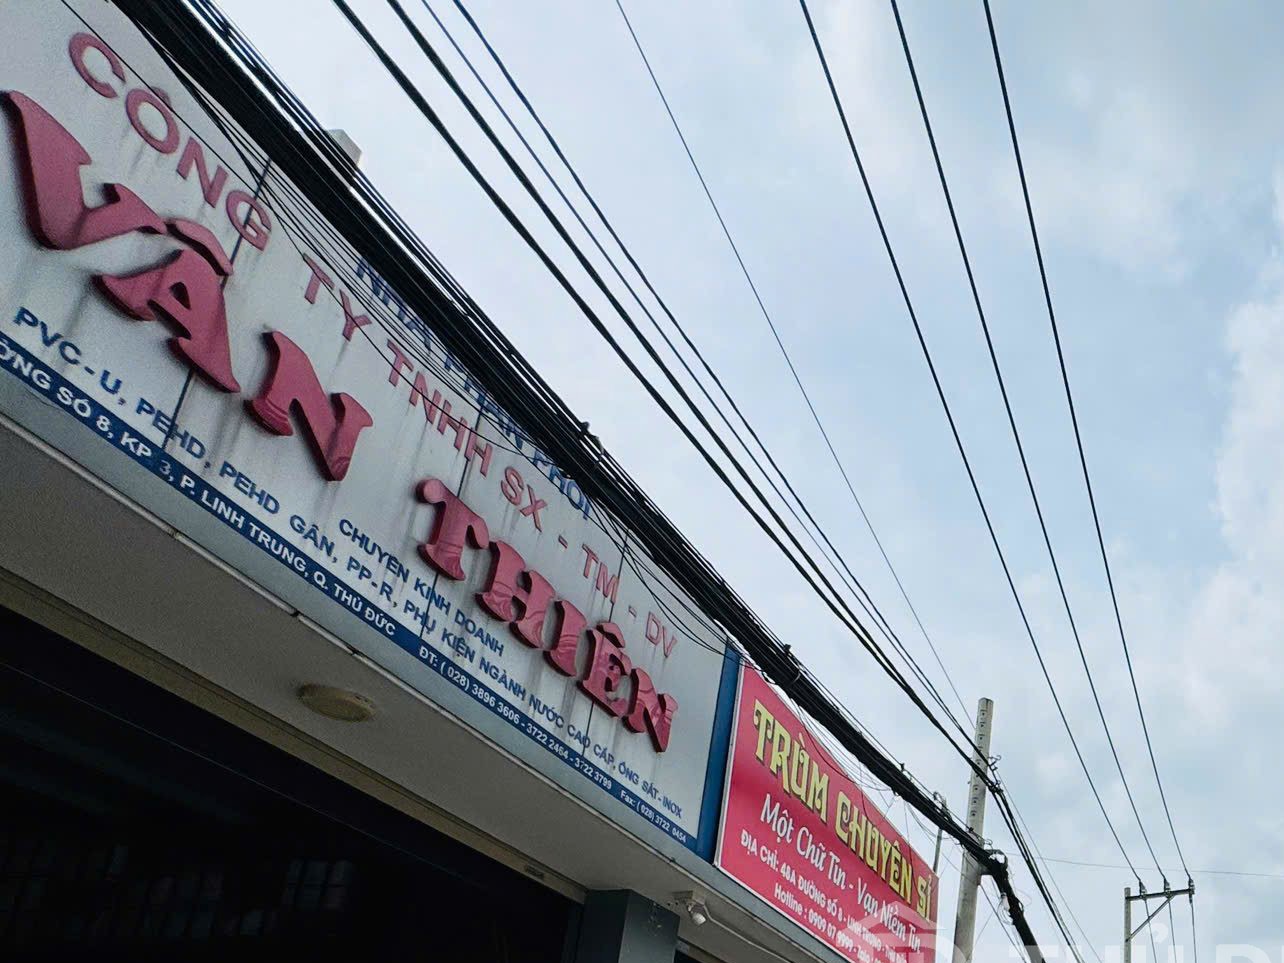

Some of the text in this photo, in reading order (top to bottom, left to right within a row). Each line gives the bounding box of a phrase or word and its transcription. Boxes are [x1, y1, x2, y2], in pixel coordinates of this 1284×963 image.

[67, 32, 272, 251] CÔNG
[304, 253, 372, 341] TY
[387, 339, 493, 478] TNHH
[500, 466, 548, 533] SX
[582, 543, 620, 605] TM
[645, 611, 678, 658] DV
[120, 431, 152, 458] KP
[180, 474, 195, 495] P.
[201, 489, 245, 528] LINH
[249, 521, 309, 578] TRUNG,
[313, 571, 328, 590] Q.
[334, 582, 362, 613] THỦ
[365, 608, 396, 636] ĐỨC
[472, 684, 496, 707] 3896
[497, 701, 520, 725] 3606
[526, 722, 548, 745] 3722
[219, 461, 280, 514] PEHD
[404, 600, 436, 634] PHỤ
[441, 627, 475, 663] KIỆN
[479, 657, 526, 701] NGÀNH
[529, 694, 564, 728] NƯỚC
[567, 724, 591, 749] CAO
[339, 519, 504, 657] CHUYÊN KINH DOANH
[416, 477, 679, 752] THIÊN
[741, 829, 758, 856] ĐỊA
[780, 862, 796, 886] 48A
[754, 699, 933, 922] TRÙM CHUYÊN SỈ
[760, 793, 794, 843] Một
[797, 826, 827, 871] Chữ
[857, 877, 878, 919] Vạn
[880, 900, 906, 942] Niềm
